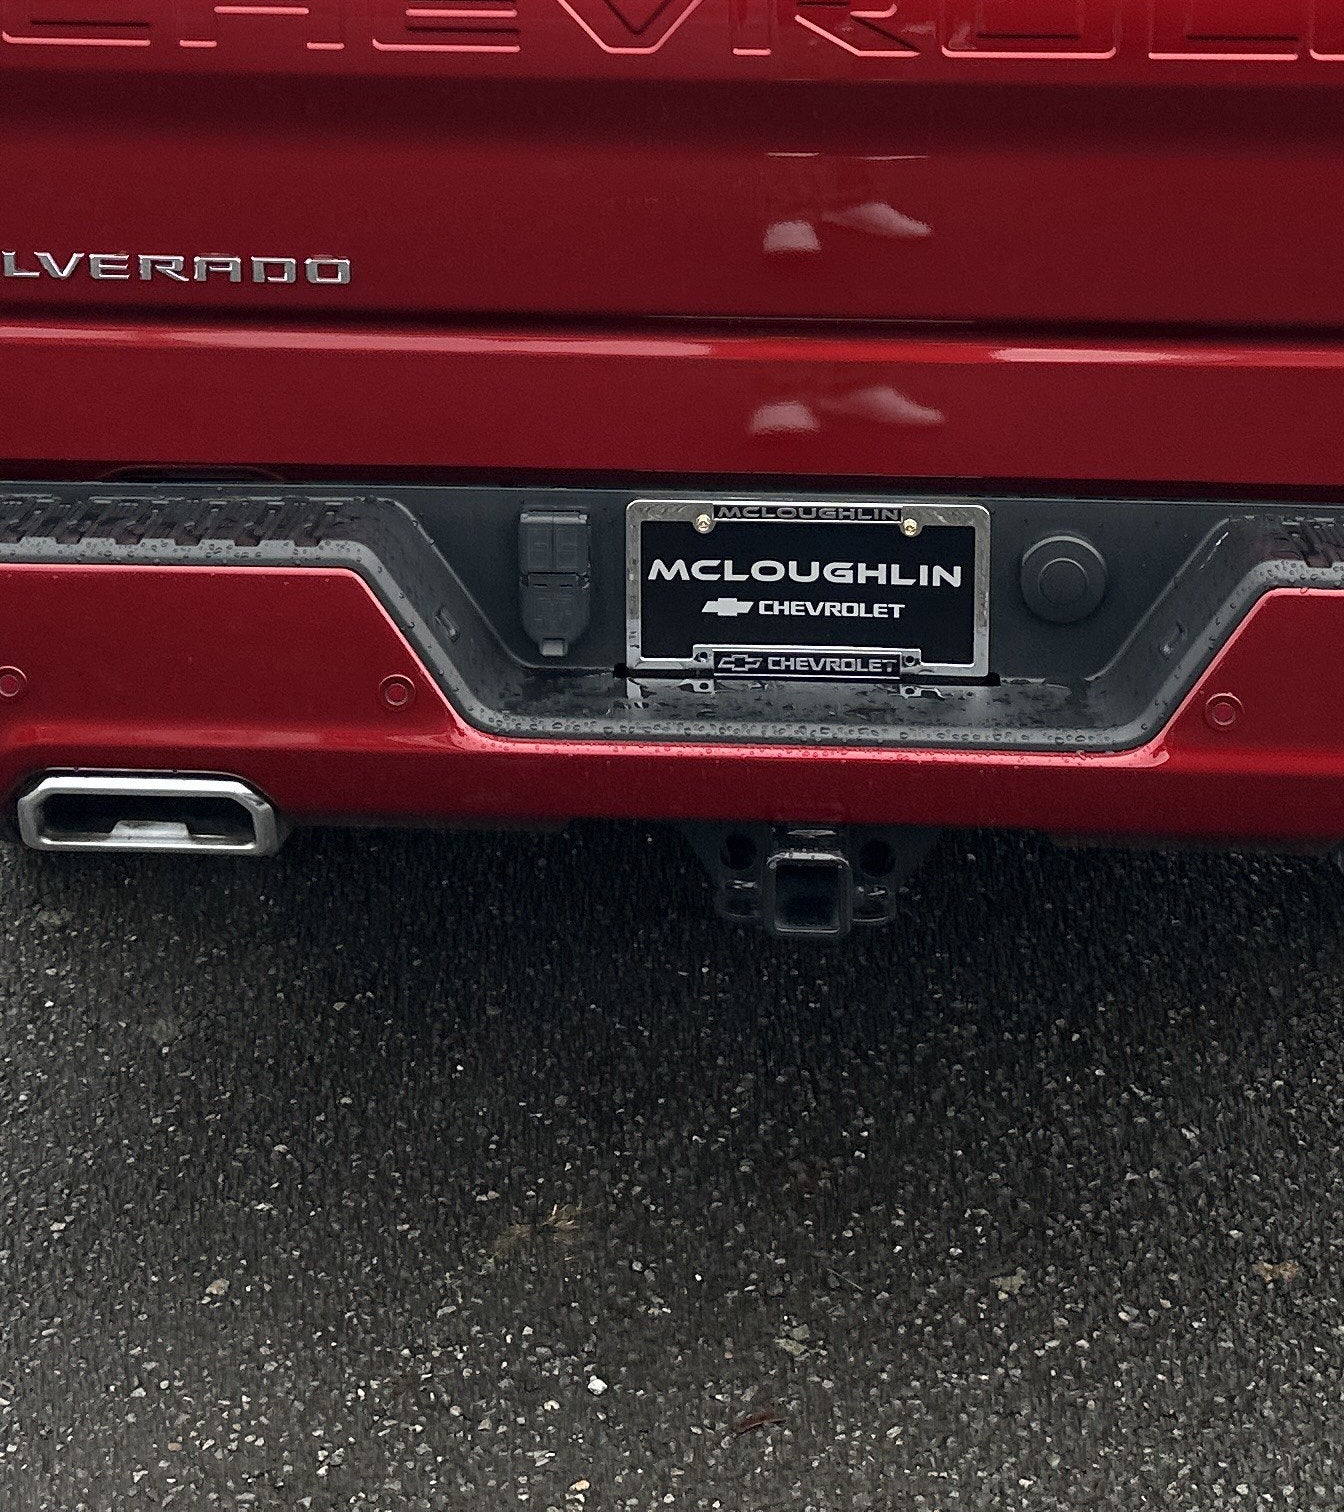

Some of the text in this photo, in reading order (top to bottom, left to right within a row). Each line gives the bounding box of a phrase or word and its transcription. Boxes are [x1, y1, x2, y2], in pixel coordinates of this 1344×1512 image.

[717, 506, 901, 521] MCLOUGHLIN
[647, 558, 963, 588] MCLOUGHLIN
[758, 599, 907, 618] CHEVROLET
[767, 656, 898, 673] CHEVROLET
